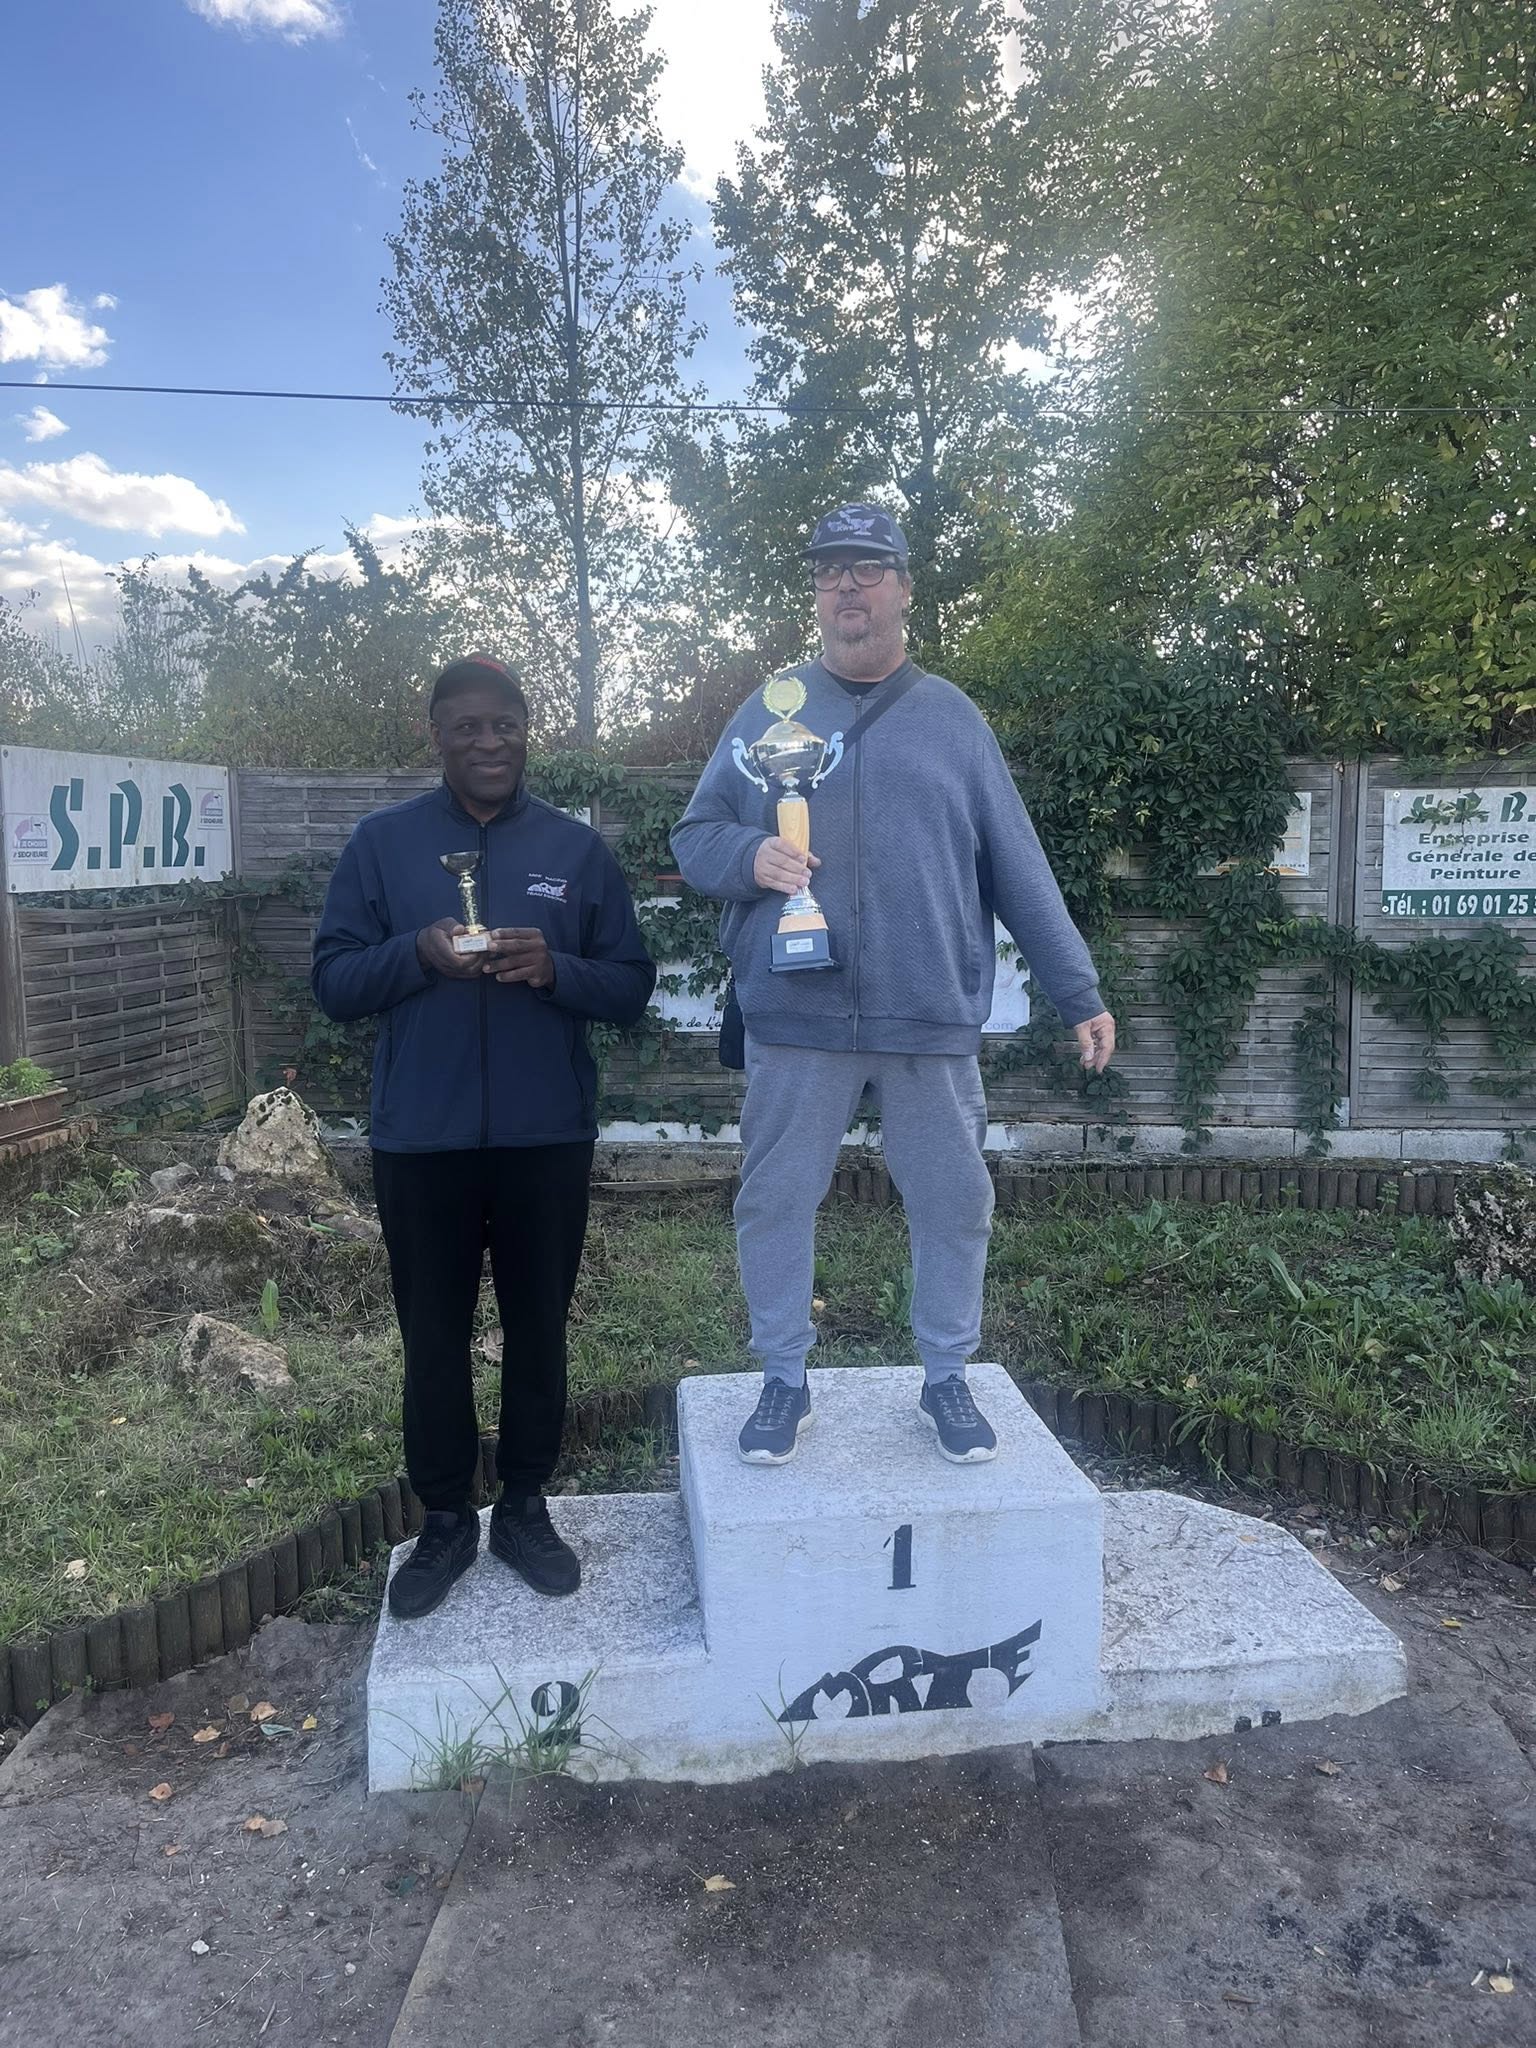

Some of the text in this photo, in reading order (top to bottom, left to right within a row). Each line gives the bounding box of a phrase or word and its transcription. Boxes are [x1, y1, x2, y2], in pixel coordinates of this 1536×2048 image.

[50, 778, 205, 870] S.P.B.
[1407, 850, 1536, 863] Générale de
[1430, 868, 1521, 879] Peinture
[1387, 893, 1416, 915] Tél.
[1432, 895, 1451, 915] 01
[1457, 895, 1478, 915] 69
[1483, 895, 1502, 915] 01
[1508, 894, 1529, 915] 25
[687, 1016, 702, 1027] de
[883, 1524, 916, 1590] 1
